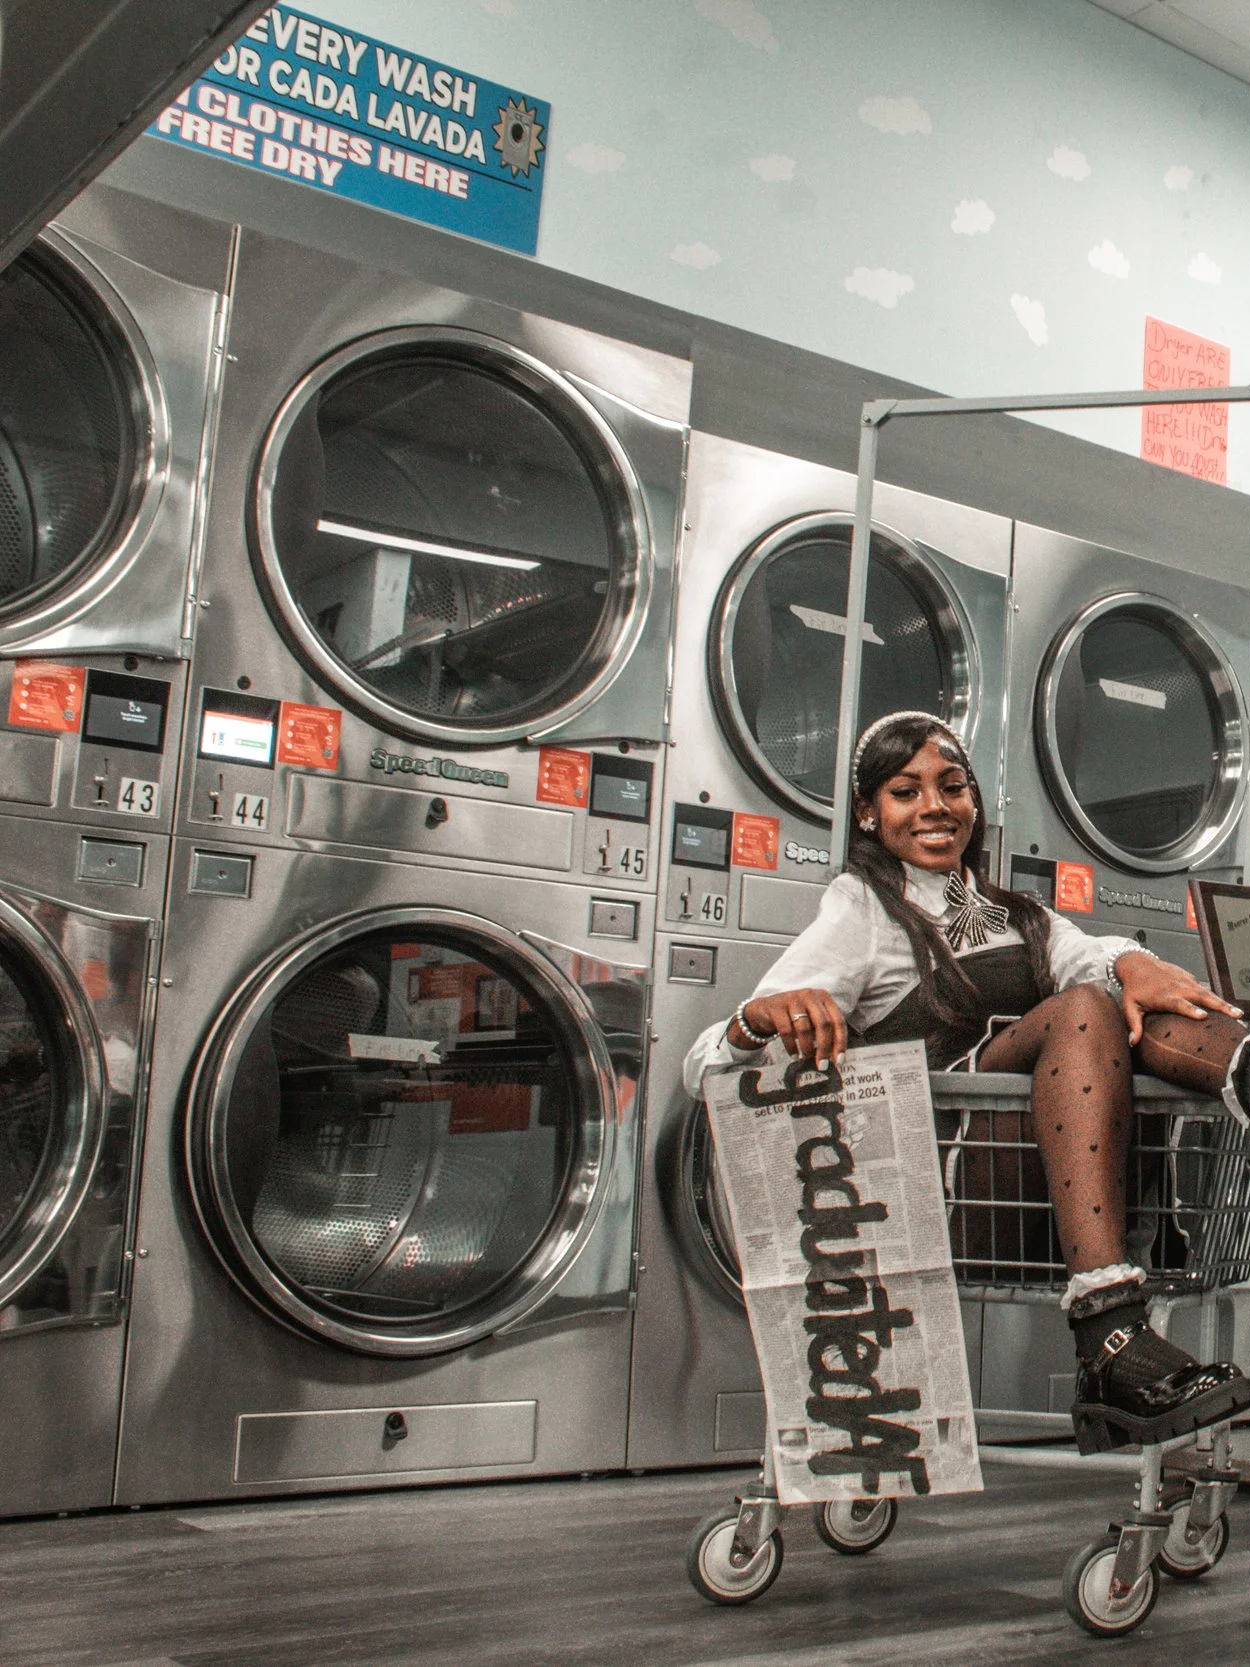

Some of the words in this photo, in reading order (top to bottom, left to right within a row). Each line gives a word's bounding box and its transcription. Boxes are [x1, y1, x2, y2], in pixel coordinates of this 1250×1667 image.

[246, 8, 368, 76] EVERY
[376, 47, 478, 118] WASH
[268, 59, 360, 121] CADA
[367, 93, 487, 165] LAVADA
[157, 107, 256, 161] FREE
[261, 137, 343, 187] DRY
[197, 85, 373, 167] CLOTHES
[378, 145, 470, 200] HERE
[1148, 322, 1193, 359] Dryer
[1196, 343, 1226, 370] ARE
[1198, 402, 1228, 427] WASH
[370, 748, 441, 774] Speed
[441, 758, 509, 788] Queen
[122, 781, 154, 812] 43
[236, 796, 264, 826] 44
[620, 848, 645, 874] 45
[702, 895, 725, 921] 46
[1099, 886, 1141, 907] Speed
[1141, 892, 1183, 915] Queen
[857, 1070, 883, 1086] work
[754, 1106, 772, 1119] set
[773, 1103, 784, 1115] to
[846, 1090, 857, 1101] in
[857, 1086, 887, 1101] 2024
